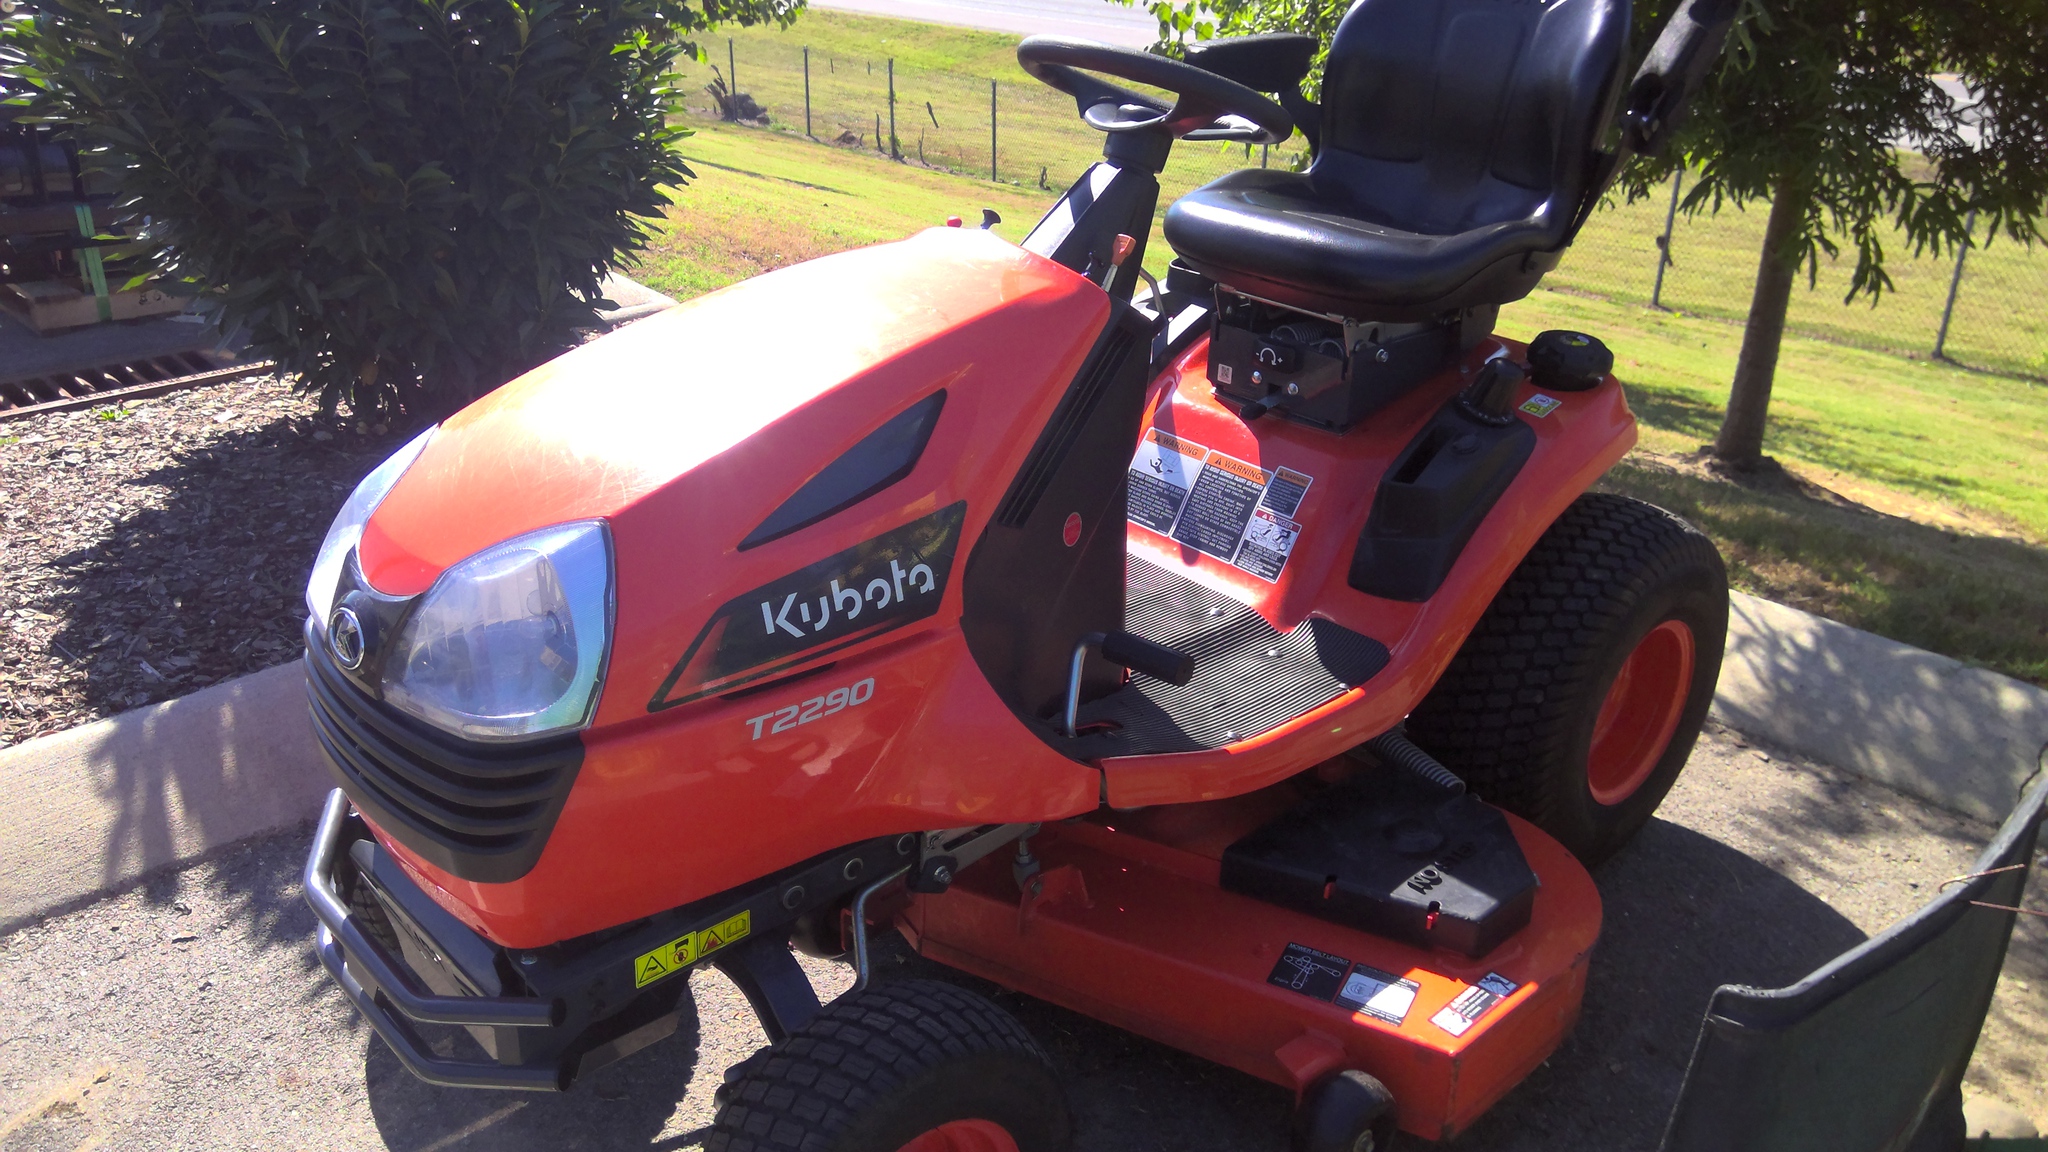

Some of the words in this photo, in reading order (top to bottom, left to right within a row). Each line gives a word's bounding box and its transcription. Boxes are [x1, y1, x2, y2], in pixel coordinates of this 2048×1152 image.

[1163, 436, 1198, 456] WARNING
[1225, 460, 1262, 480] WARNING
[1285, 473, 1308, 485] WARNING
[1269, 516, 1293, 529] DANGER
[761, 560, 935, 638] Kubota
[746, 677, 875, 741] T2290
[1288, 943, 1312, 954] MOWER
[1312, 949, 1326, 958] BELT
[1326, 953, 1350, 965] LAYOUT
